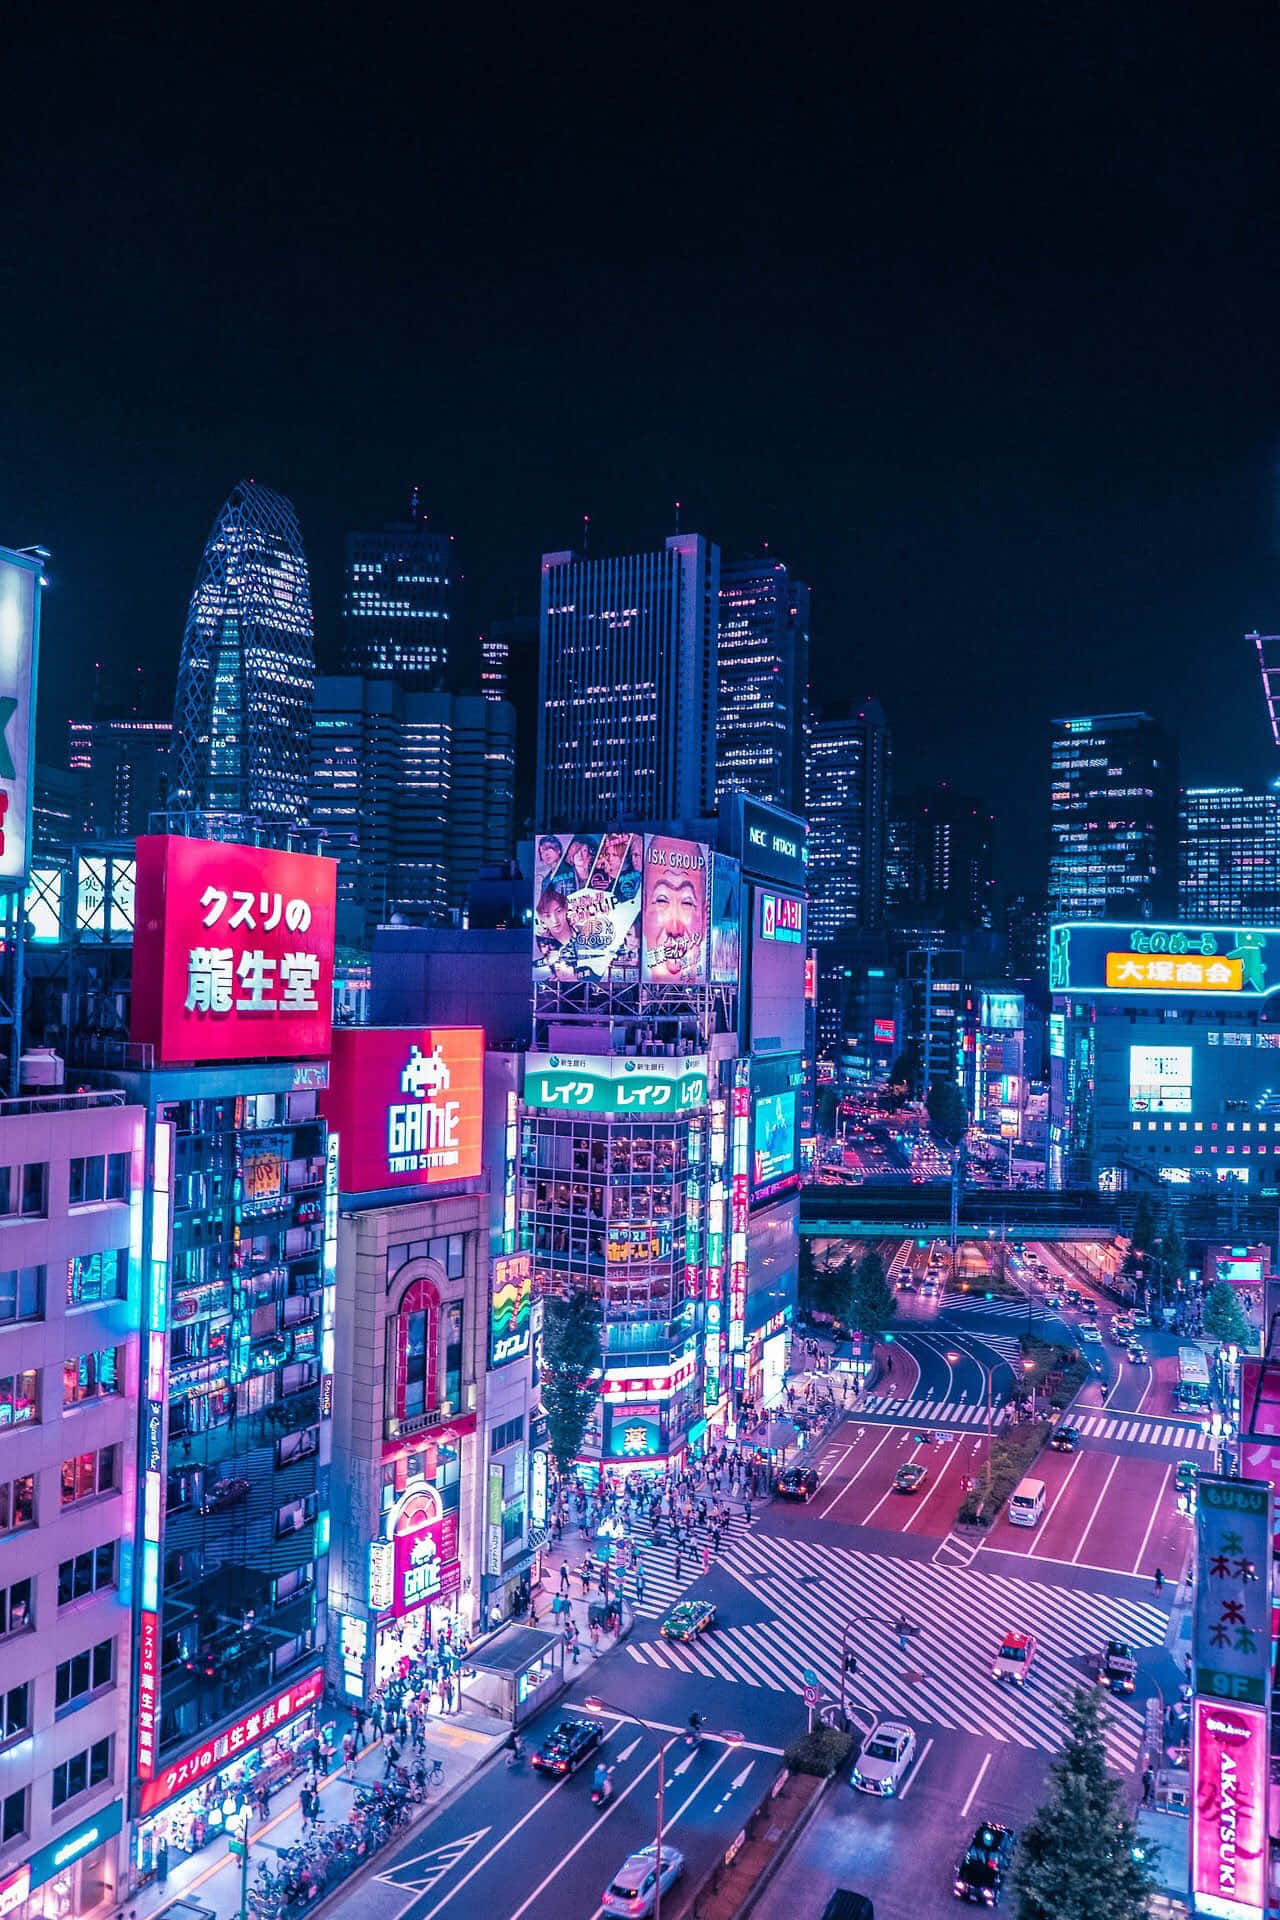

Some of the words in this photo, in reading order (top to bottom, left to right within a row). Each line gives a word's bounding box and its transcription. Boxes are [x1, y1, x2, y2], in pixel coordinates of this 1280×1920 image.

[749, 826, 767, 848] NEC
[648, 847, 666, 866] ISK
[669, 851, 705, 871] GROUP
[200, 885, 311, 932] クスリの
[1131, 930, 1217, 955] たのめーる
[184, 947, 320, 1012] 龍生堂
[1117, 960, 1232, 983] 大塚商会
[541, 1080, 594, 1105] レイク
[617, 1085, 671, 1105] レイク
[682, 1079, 703, 1105] レイク
[389, 1101, 460, 1154] GAME
[1212, 1673, 1249, 1697] 9F
[1218, 1752, 1238, 1895] AKATSUKI
